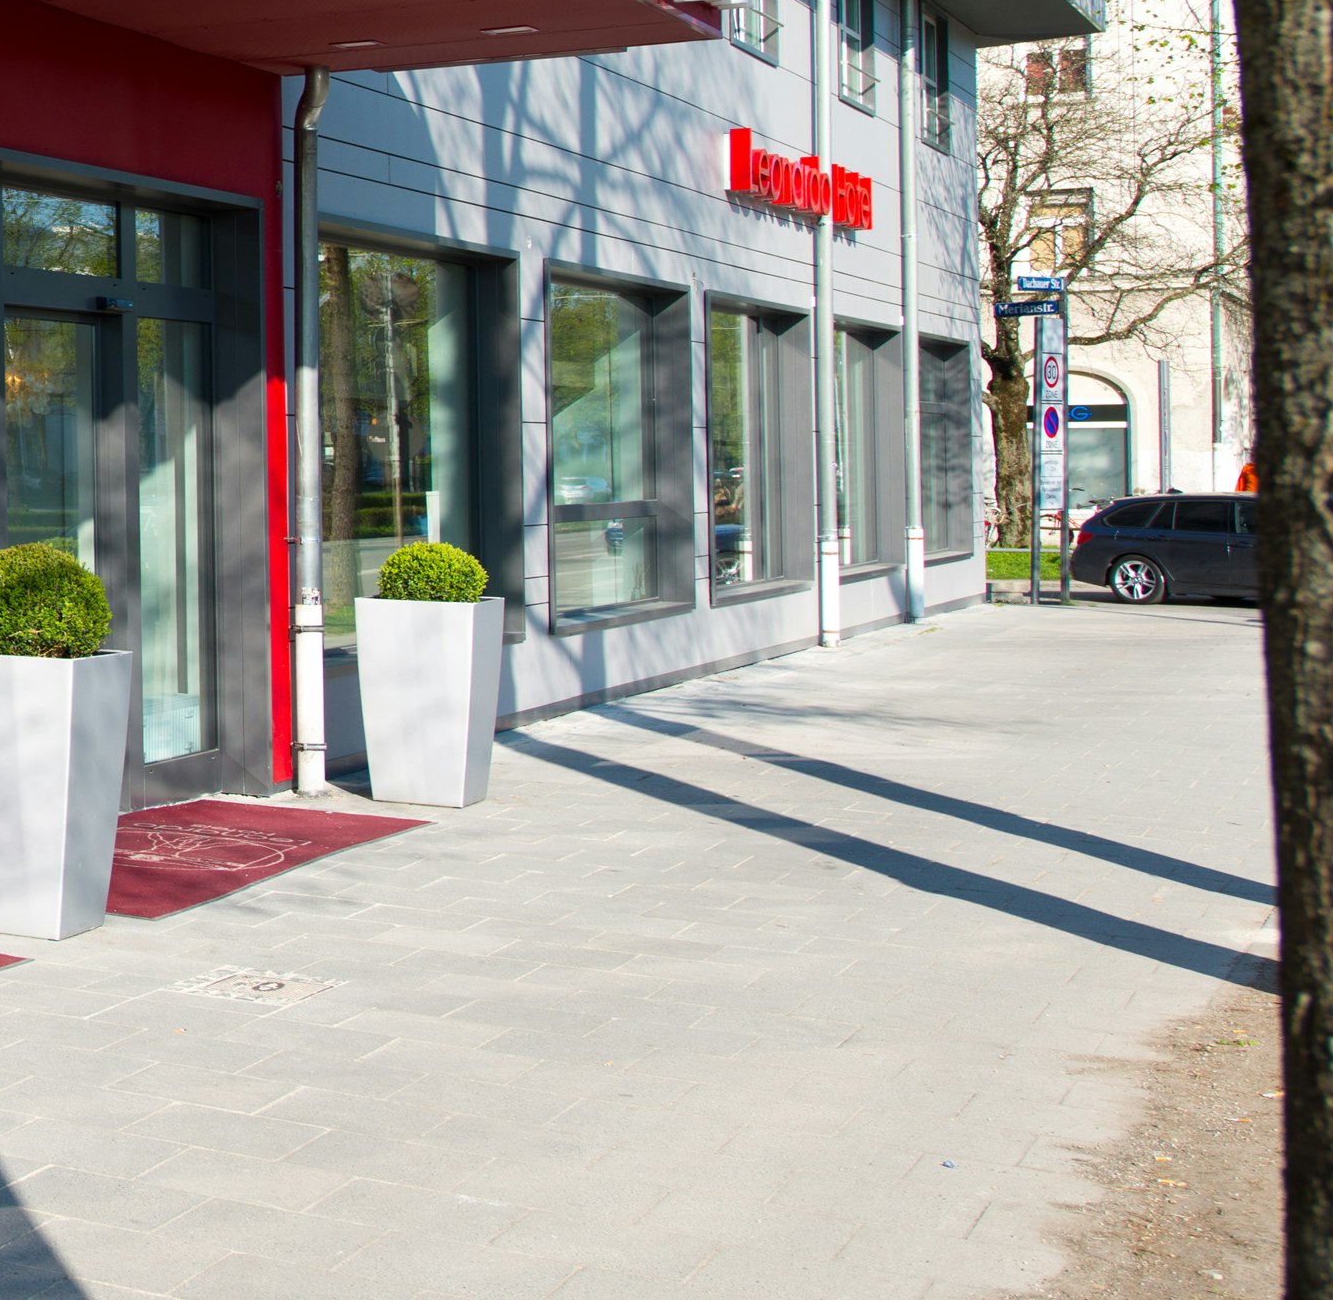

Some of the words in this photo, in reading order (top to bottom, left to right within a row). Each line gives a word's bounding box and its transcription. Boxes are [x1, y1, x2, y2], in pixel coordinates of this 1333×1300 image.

[729, 127, 831, 217] Leonardo
[998, 303, 1055, 315] Merianstr.
[1045, 364, 1058, 380] 30
